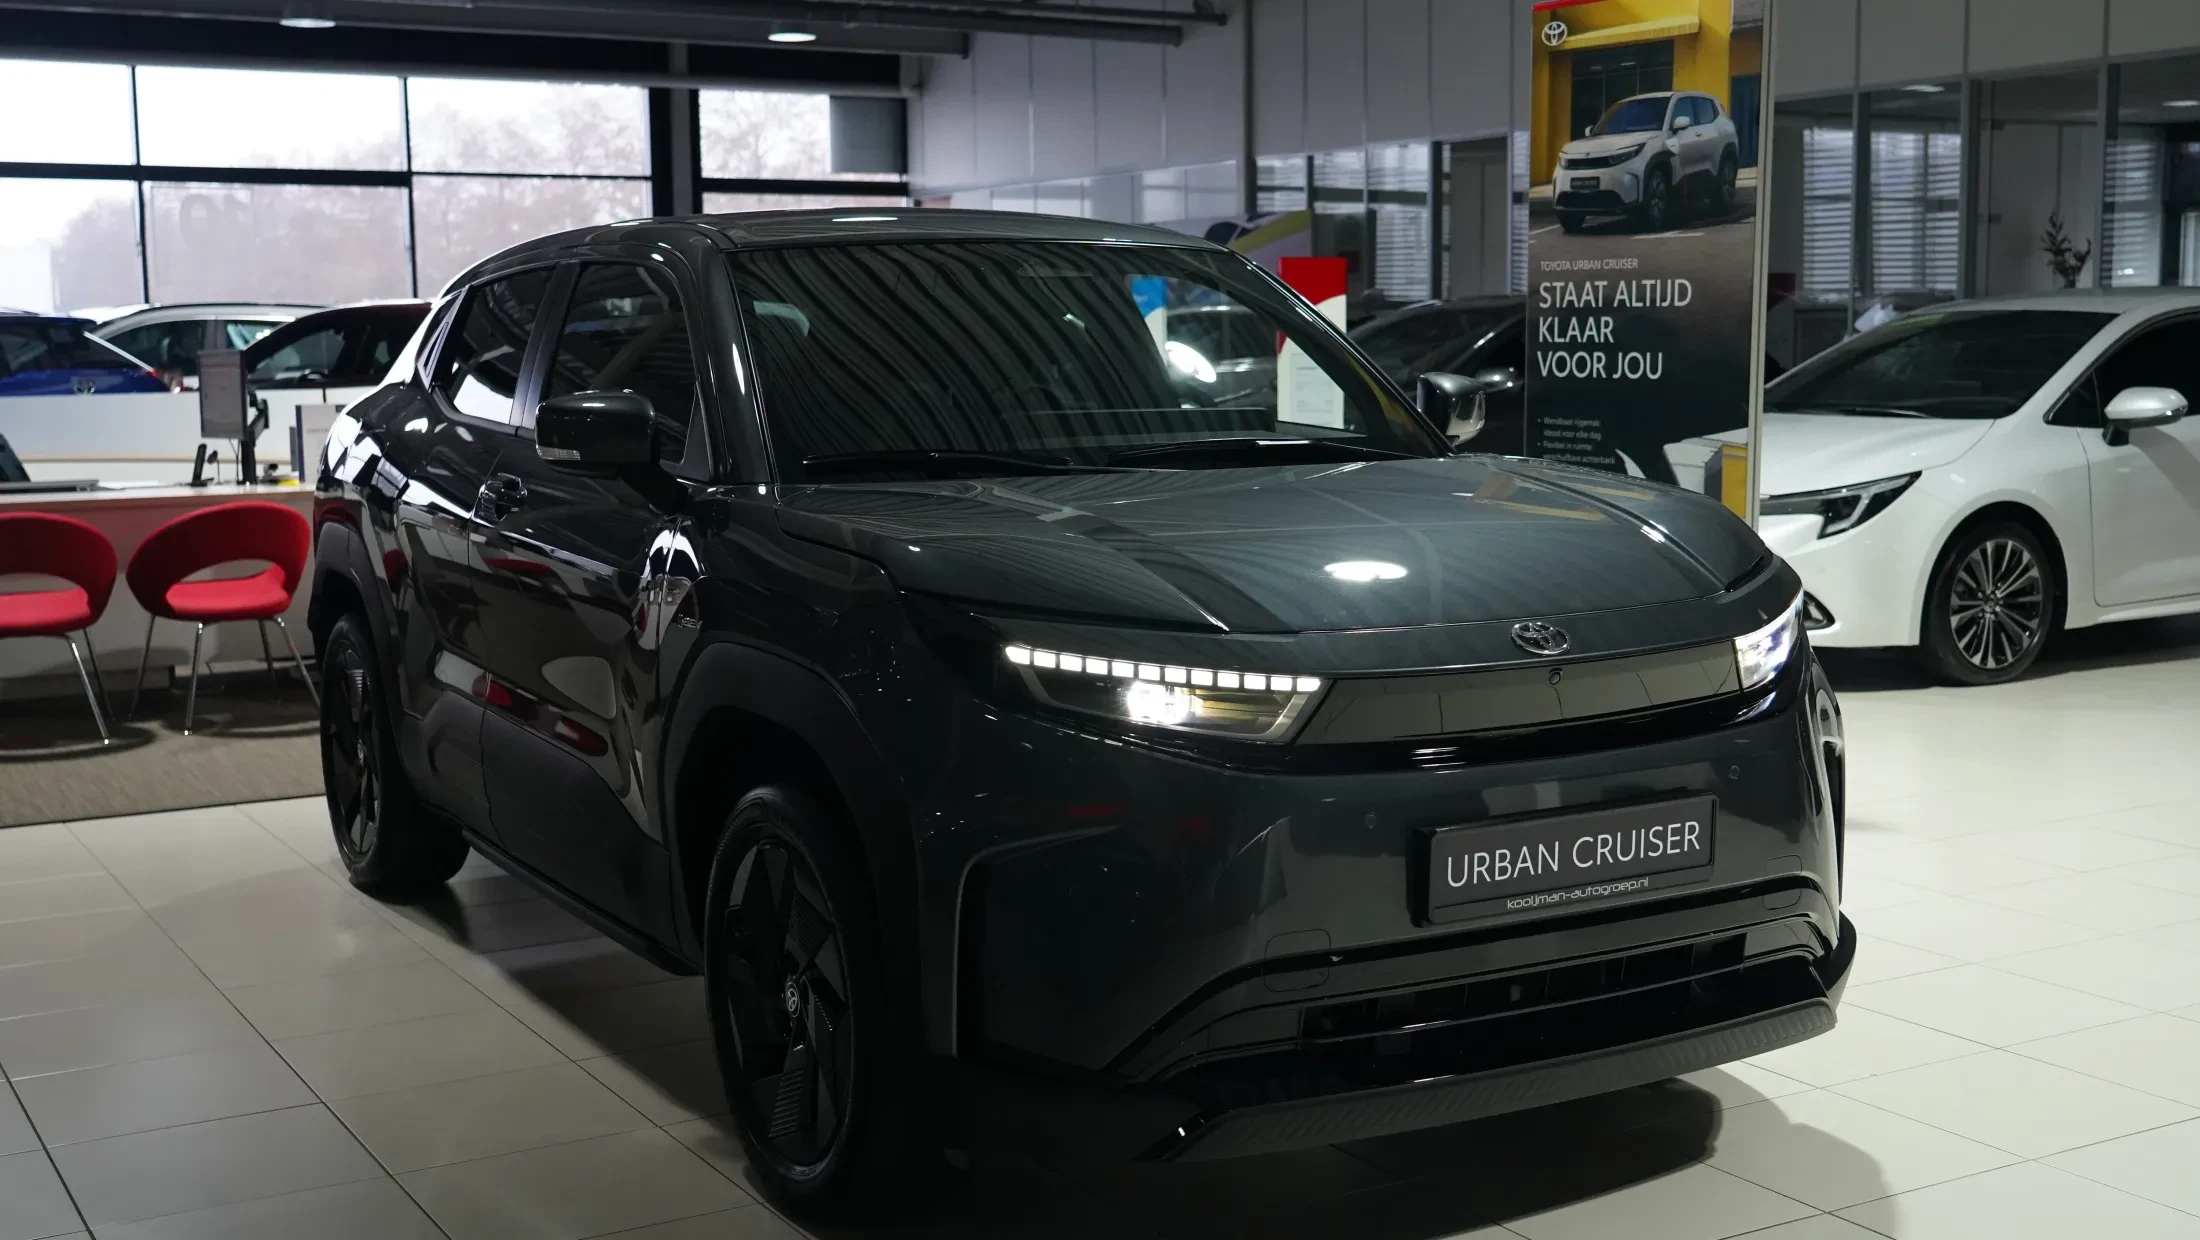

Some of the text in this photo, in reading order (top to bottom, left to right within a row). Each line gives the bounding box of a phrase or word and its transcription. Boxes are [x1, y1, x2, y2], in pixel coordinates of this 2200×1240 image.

[1541, 258, 1638, 271] TOYOTA URBAN CRUISER
[1539, 279, 1692, 308] STAAT ALTIJD
[1539, 316, 1614, 343] KLAAR
[1537, 351, 1662, 379] VOOR JOU
[1576, 431, 1588, 439] elke
[1589, 431, 1602, 441] dag
[1447, 821, 1701, 888] URBAN CRUISER
[1507, 877, 1649, 909] kooijman-autogroep.nl
